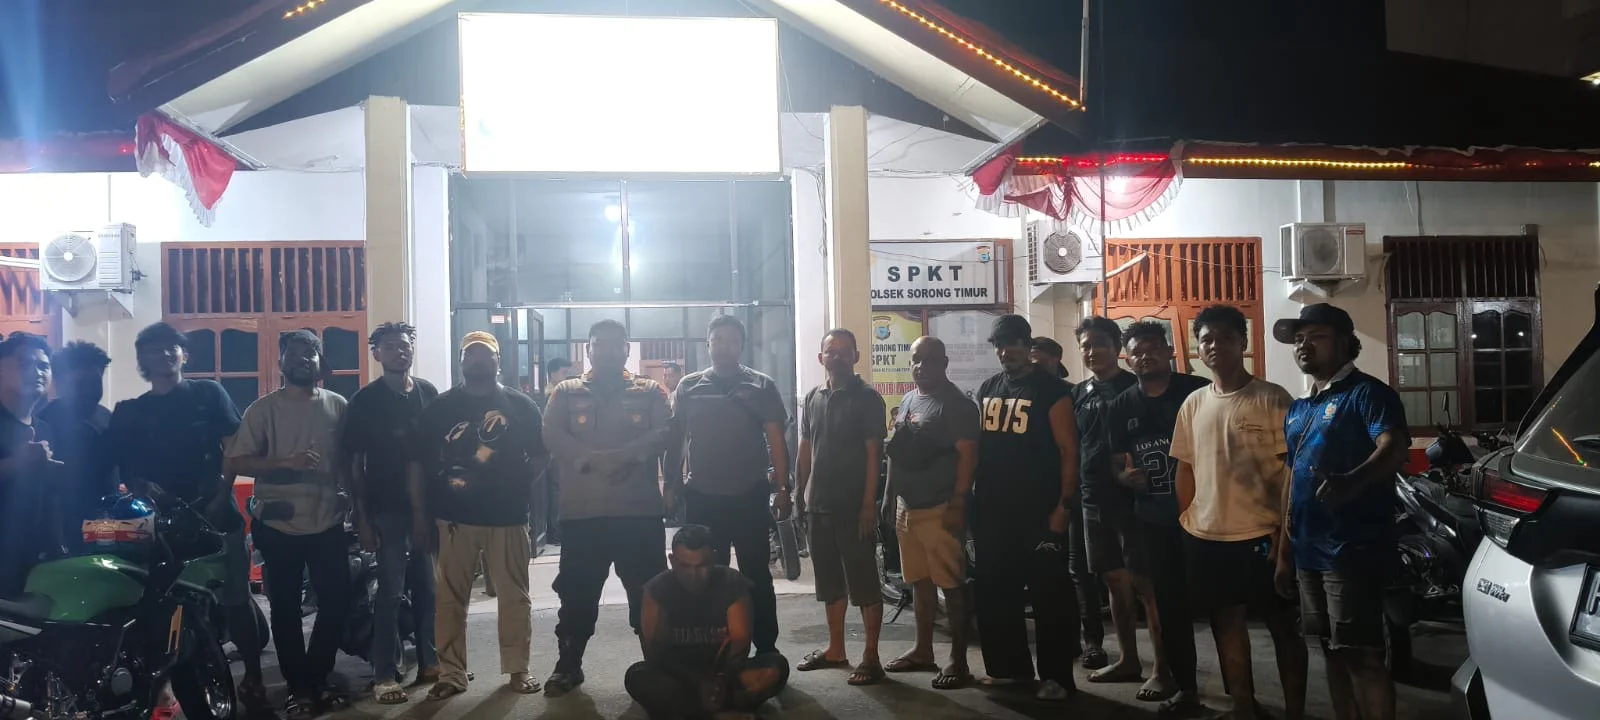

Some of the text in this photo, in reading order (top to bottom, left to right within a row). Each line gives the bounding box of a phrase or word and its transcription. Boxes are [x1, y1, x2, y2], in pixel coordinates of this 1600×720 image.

[907, 288, 951, 299] SORONG
[954, 287, 988, 298] TIMUR
[897, 343, 912, 352] TIM
[983, 397, 1033, 434] 1975
[1135, 440, 1152, 452] LOS
[1143, 450, 1177, 495] 2
